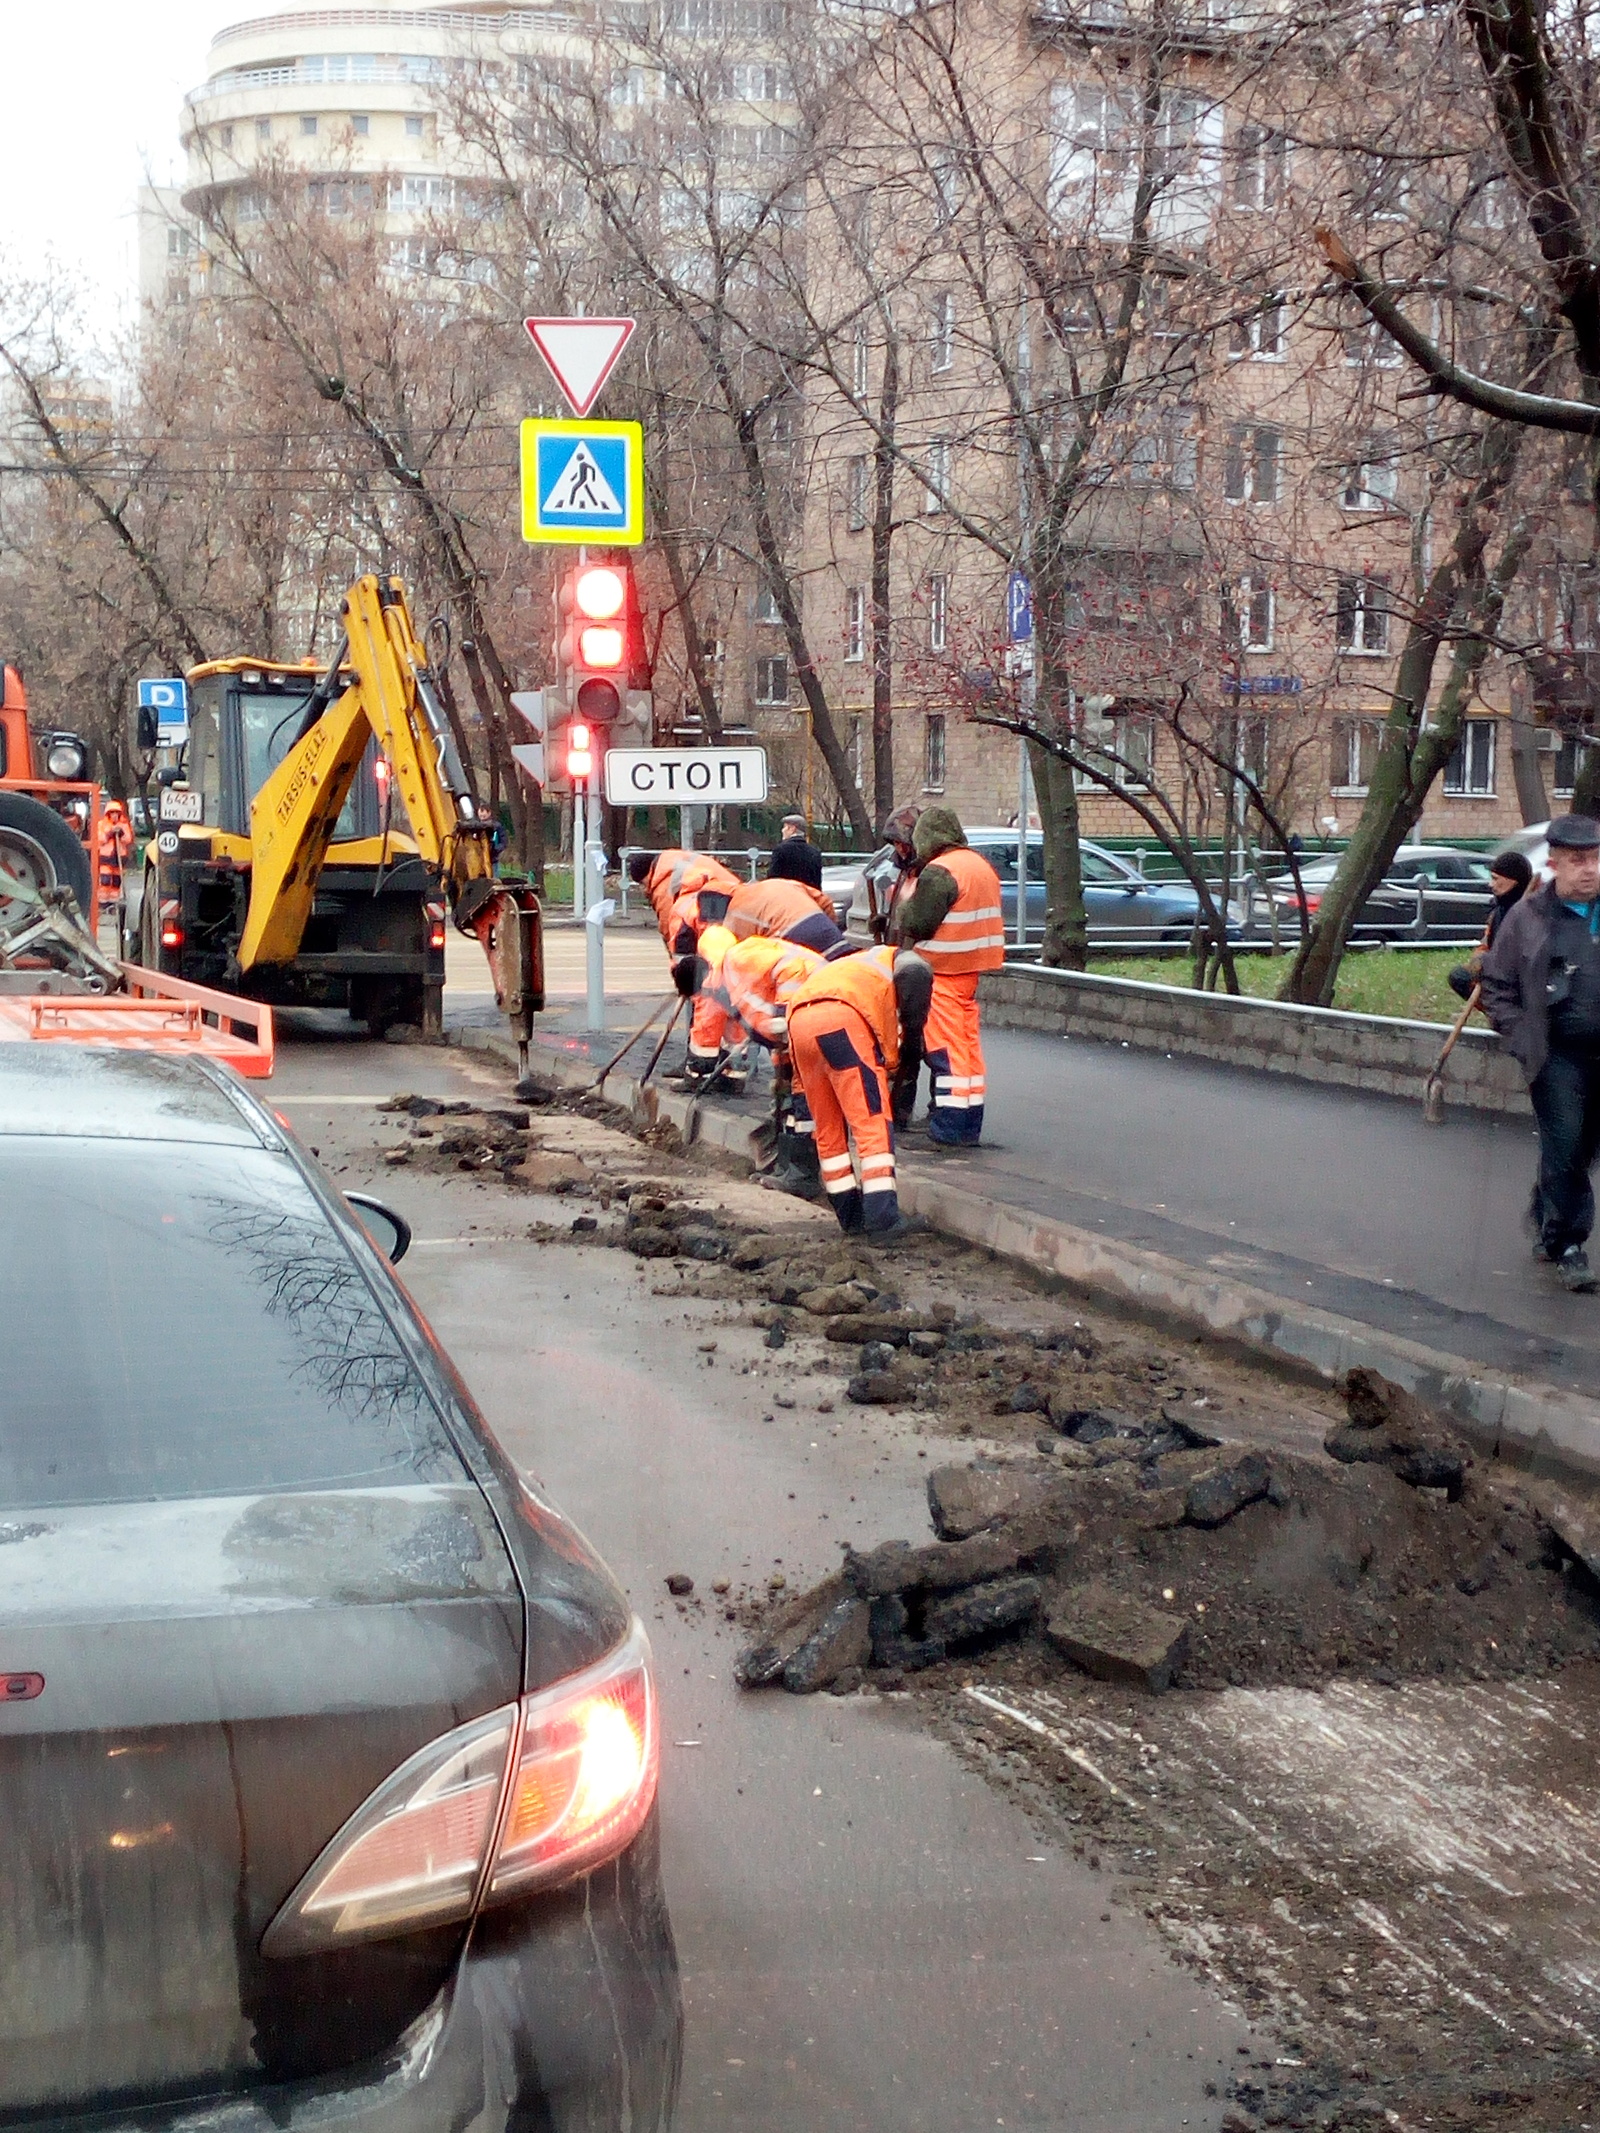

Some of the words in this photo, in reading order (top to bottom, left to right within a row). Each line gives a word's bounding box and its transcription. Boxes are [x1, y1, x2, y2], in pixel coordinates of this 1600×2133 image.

[1013, 579, 1026, 632] P
[631, 761, 741, 791] СТОП
[166, 793, 196, 806] 6421
[186, 810, 198, 819] 77
[160, 836, 176, 848] 40
